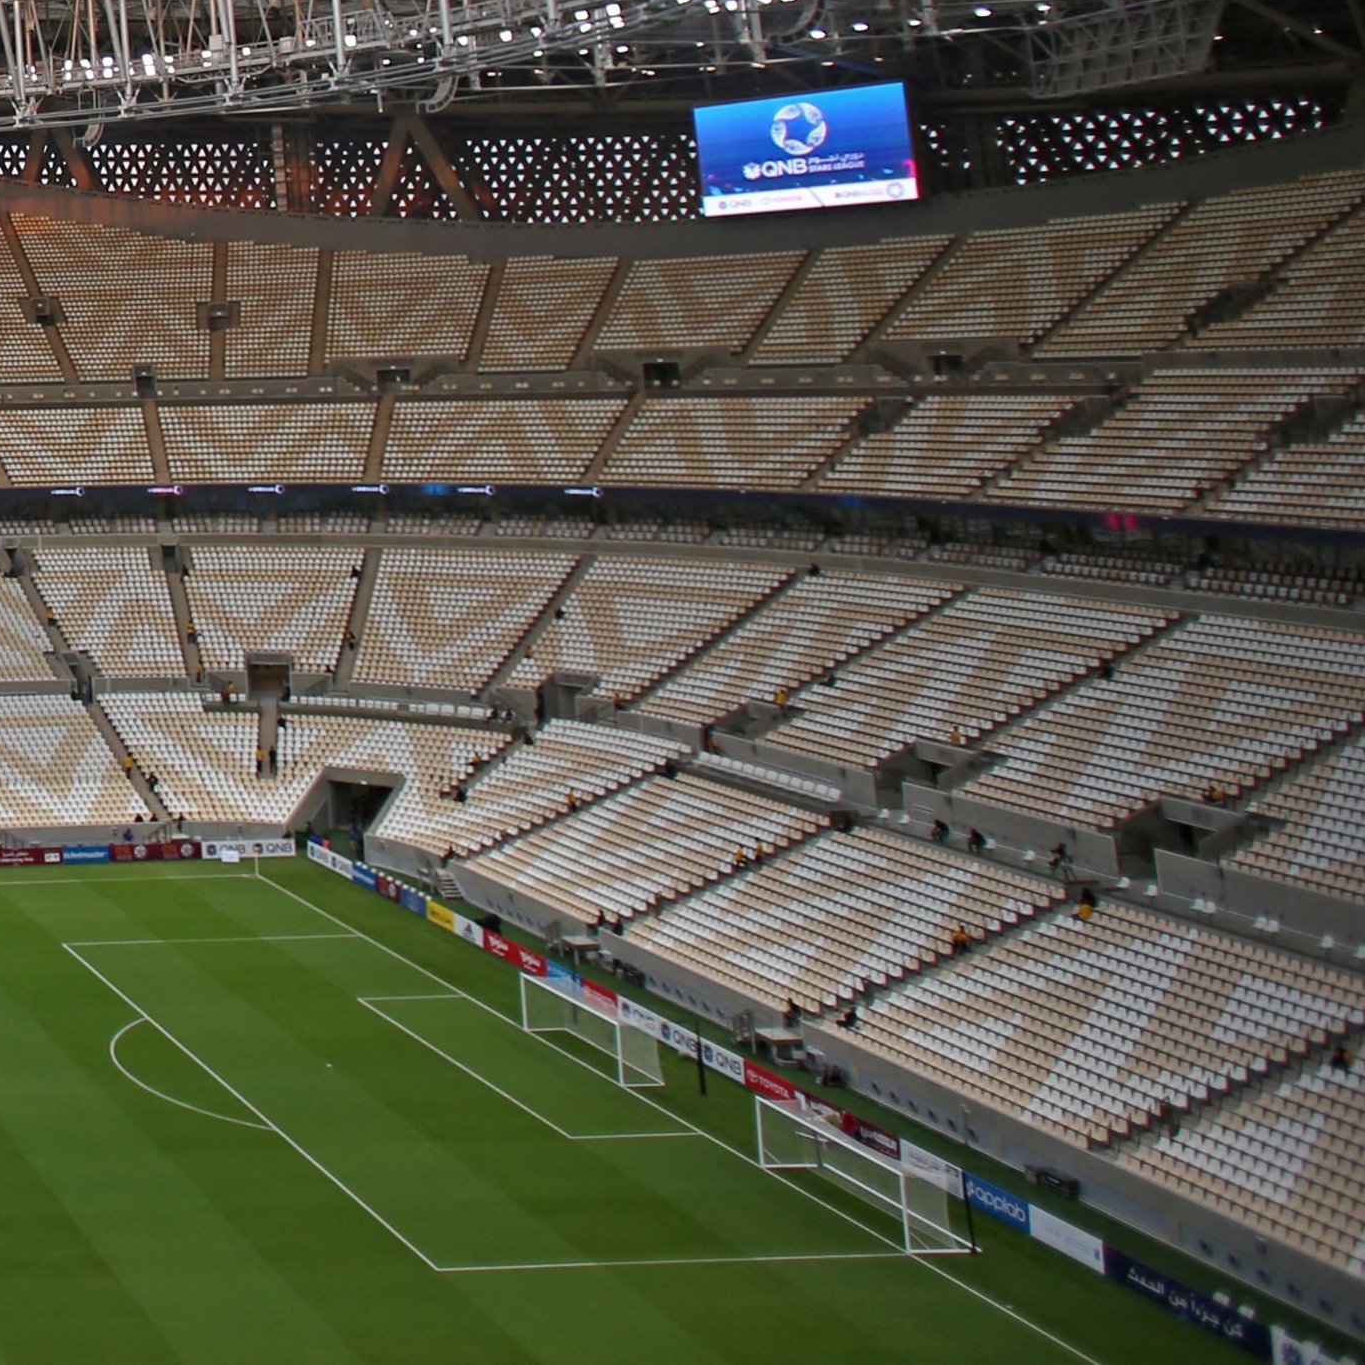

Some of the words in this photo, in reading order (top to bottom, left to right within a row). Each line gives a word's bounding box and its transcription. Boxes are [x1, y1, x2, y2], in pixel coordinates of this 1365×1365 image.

[762, 159, 808, 178] QNB
[809, 164, 832, 173] STARS
[833, 160, 865, 170] LEAGUE
[266, 842, 292, 853] QNB
[673, 1030, 698, 1053] QNB
[716, 1052, 741, 1076] QNB
[758, 1076, 789, 1099] TOYOTA
[975, 1185, 1026, 1222] applab
